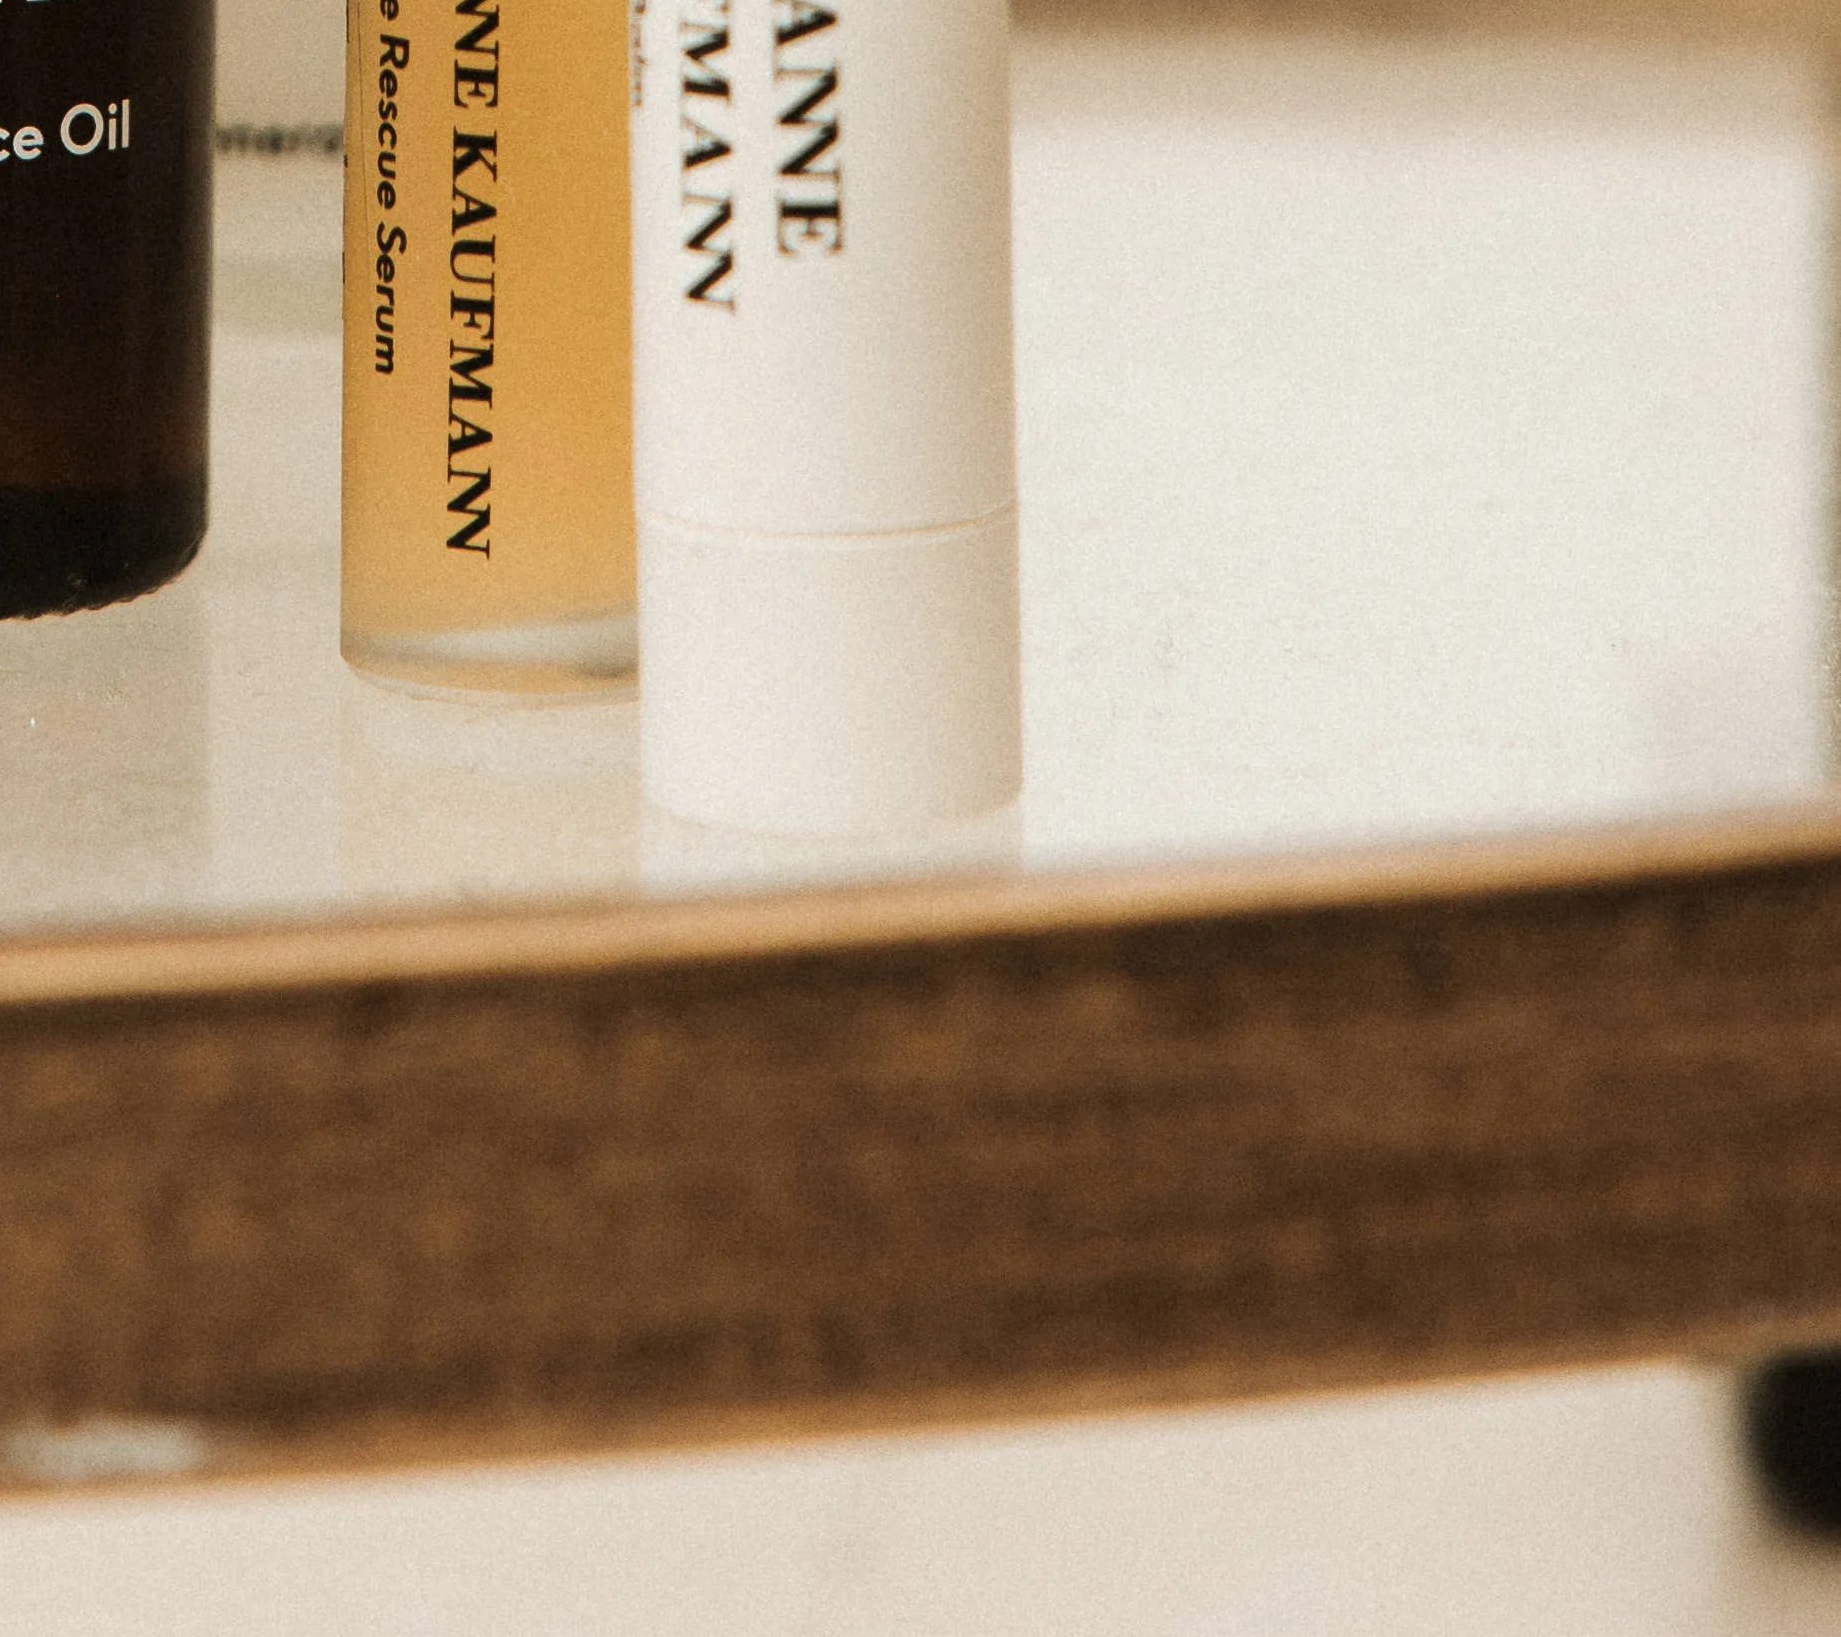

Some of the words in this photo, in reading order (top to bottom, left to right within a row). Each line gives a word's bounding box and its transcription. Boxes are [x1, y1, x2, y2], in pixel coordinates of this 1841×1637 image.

[60, 99, 130, 155] Oil
[376, 33, 411, 210] Rescue
[375, 220, 408, 375] Serum
[446, 125, 498, 560] KAUFMANN
